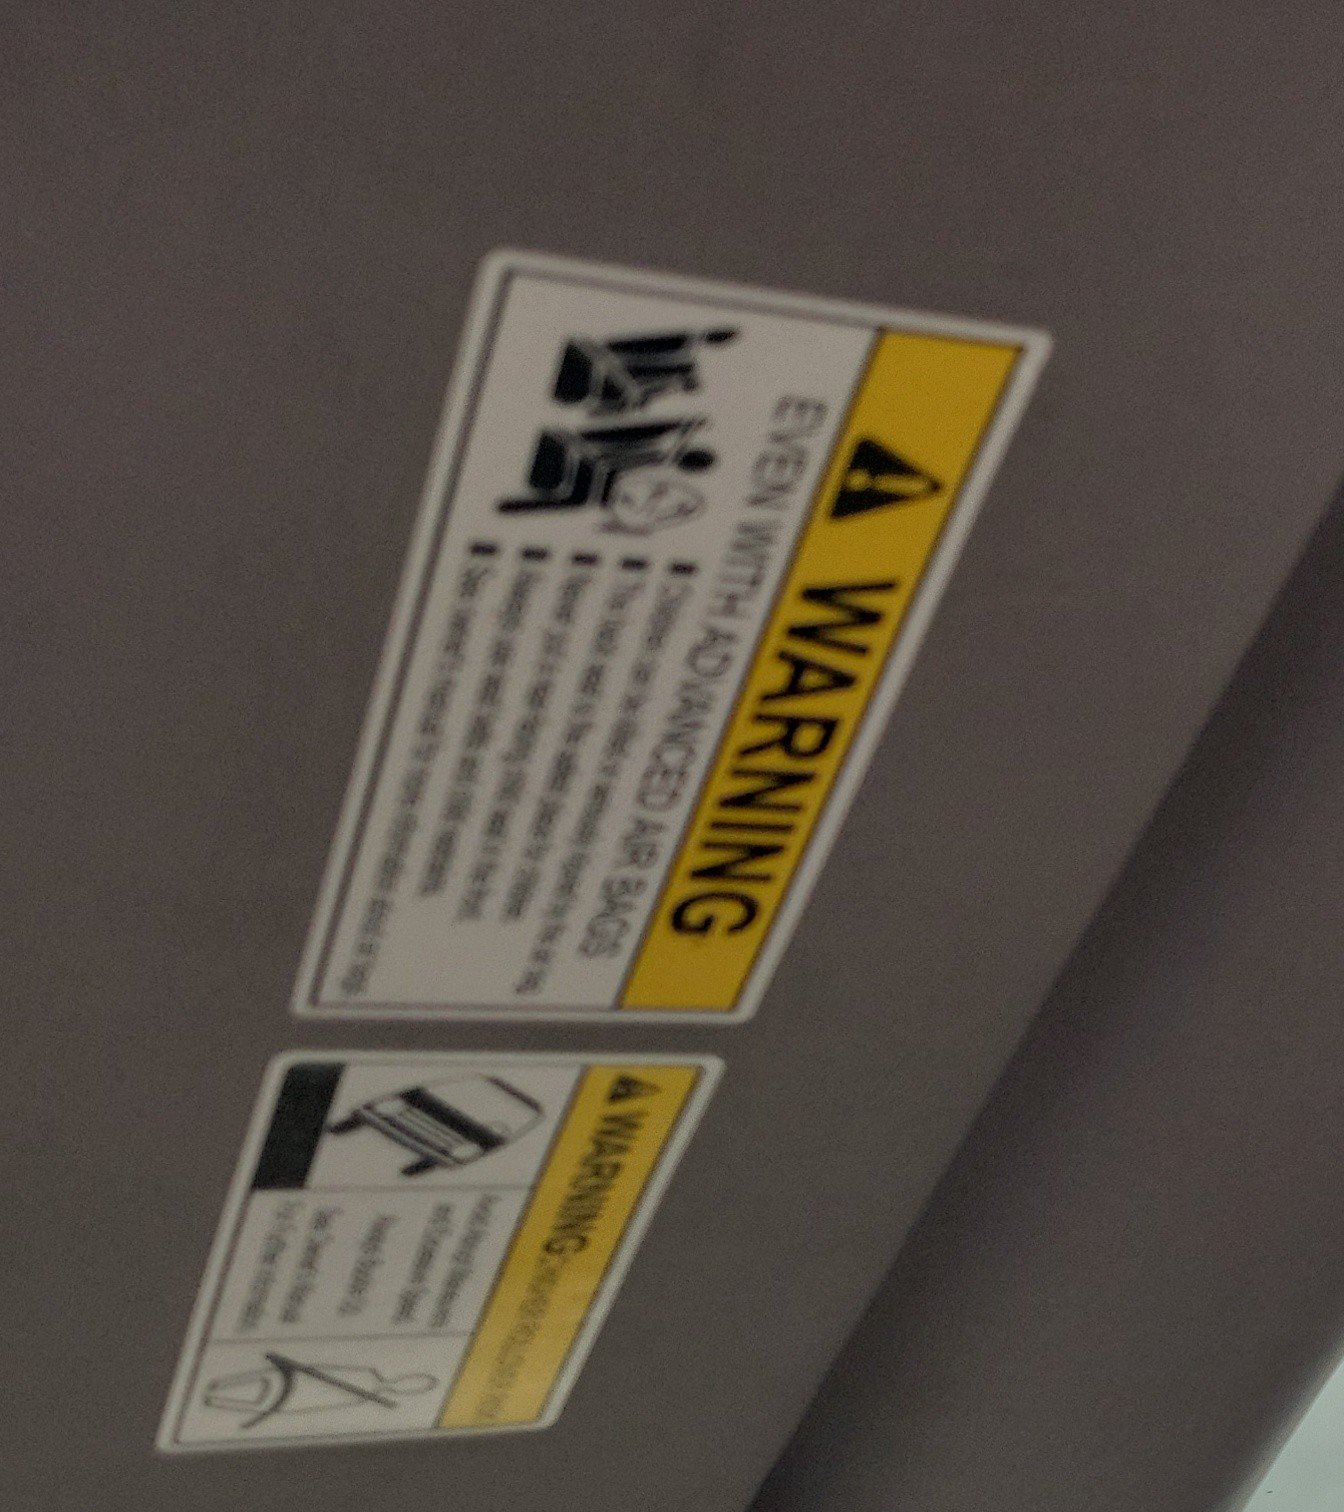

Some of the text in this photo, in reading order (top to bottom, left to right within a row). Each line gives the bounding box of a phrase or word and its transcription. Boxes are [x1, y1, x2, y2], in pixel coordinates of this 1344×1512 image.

[578, 396, 827, 960] EVEN WITH ADVANCED AIR BAGS
[670, 578, 896, 939] WARNING
[543, 1114, 644, 1254] WARNING
